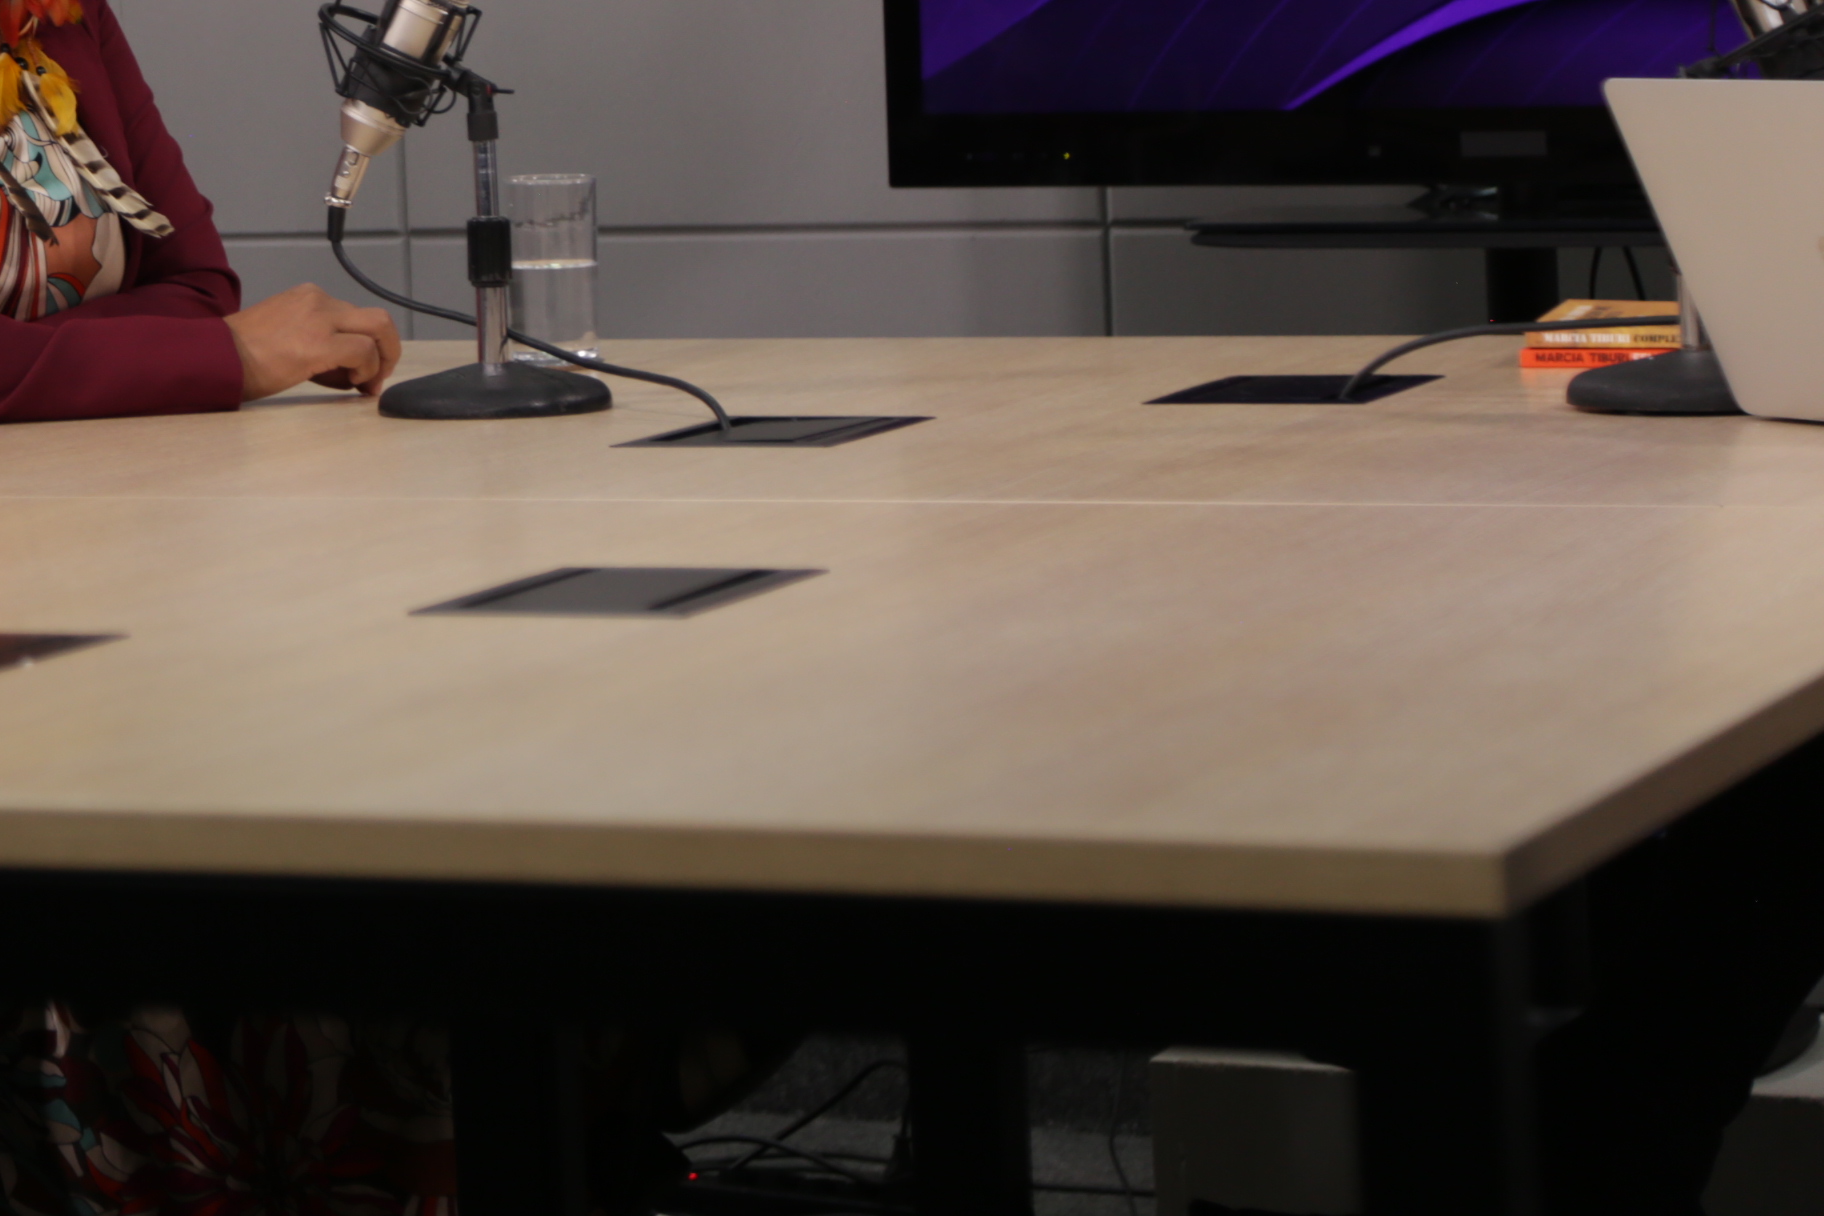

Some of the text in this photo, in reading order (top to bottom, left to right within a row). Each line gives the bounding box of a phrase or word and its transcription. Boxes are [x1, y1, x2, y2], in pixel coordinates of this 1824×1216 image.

[1542, 333, 1679, 343] MARCIA TIBURI COMPLE
[1535, 352, 1584, 362] MARCIA
[1590, 352, 1631, 362] TIBURI
